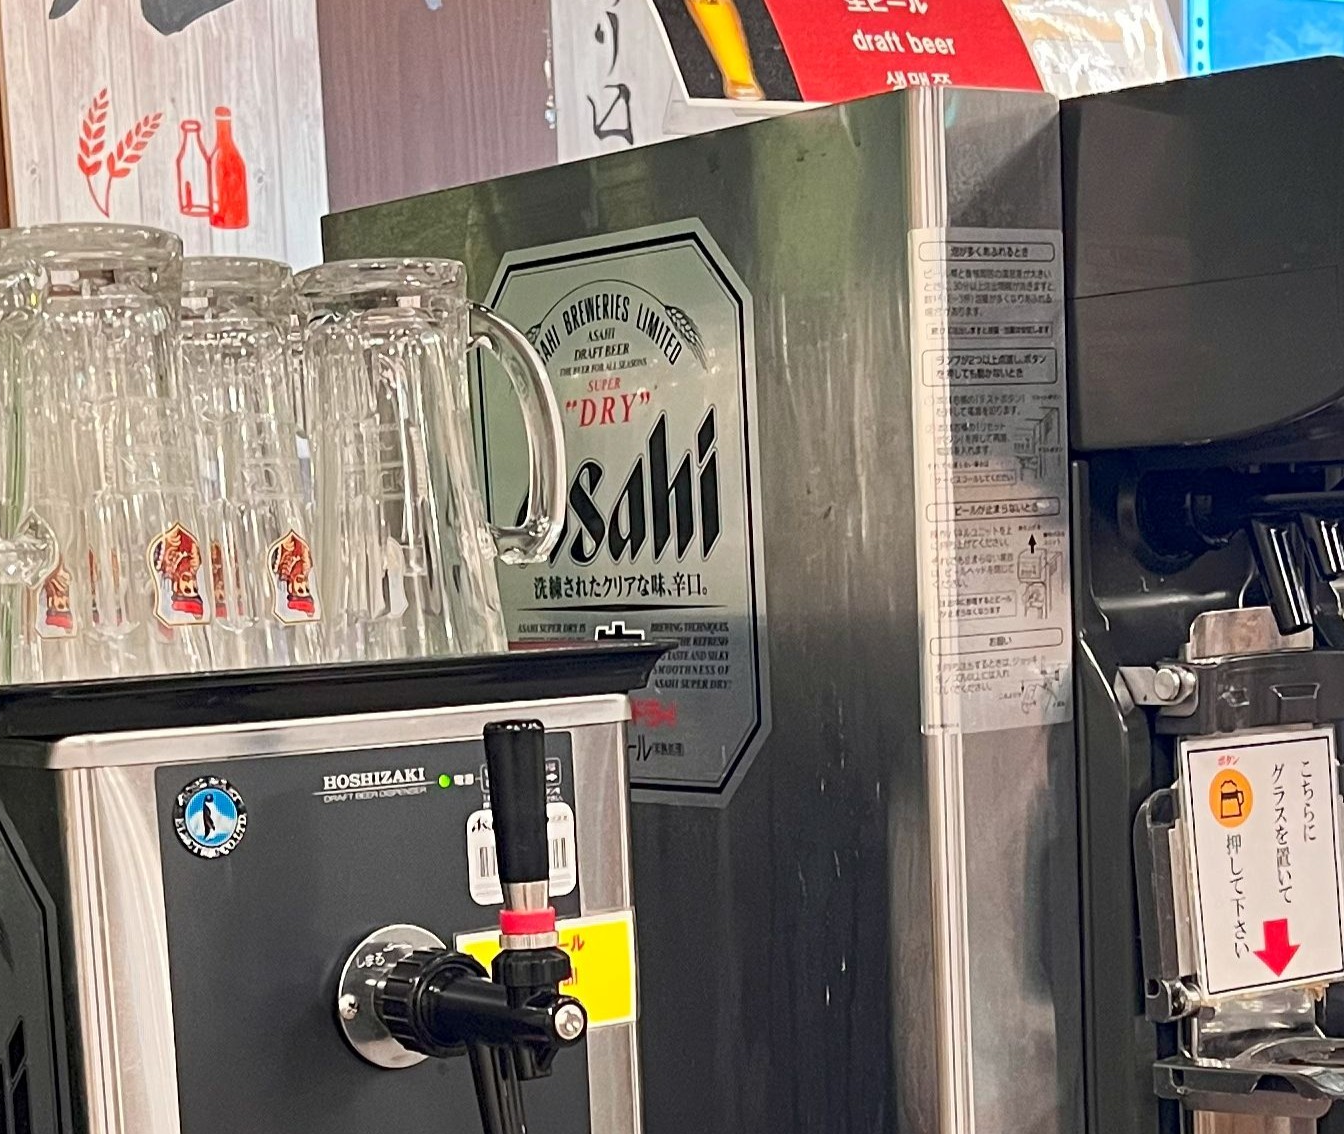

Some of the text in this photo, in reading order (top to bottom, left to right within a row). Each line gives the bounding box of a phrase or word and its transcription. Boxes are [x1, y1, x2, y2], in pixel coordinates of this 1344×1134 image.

[853, 29, 956, 55] draft beer
[535, 293, 683, 366] SAHI BREWERIES LIMITED
[587, 327, 616, 342] ASAHI
[574, 343, 630, 361] DRAFT BEER
[587, 377, 621, 393] SUPER
[533, 569, 713, 600] 洗練されたクリアな味、辛口。
[323, 767, 426, 790] HOSHIZAKI
[323, 792, 354, 804] DRAFT
[1300, 760, 1317, 843] こちらに
[1271, 763, 1293, 904] グラスを置いて
[1225, 834, 1249, 960] 押して下さい
[356, 953, 385, 969] しまる
